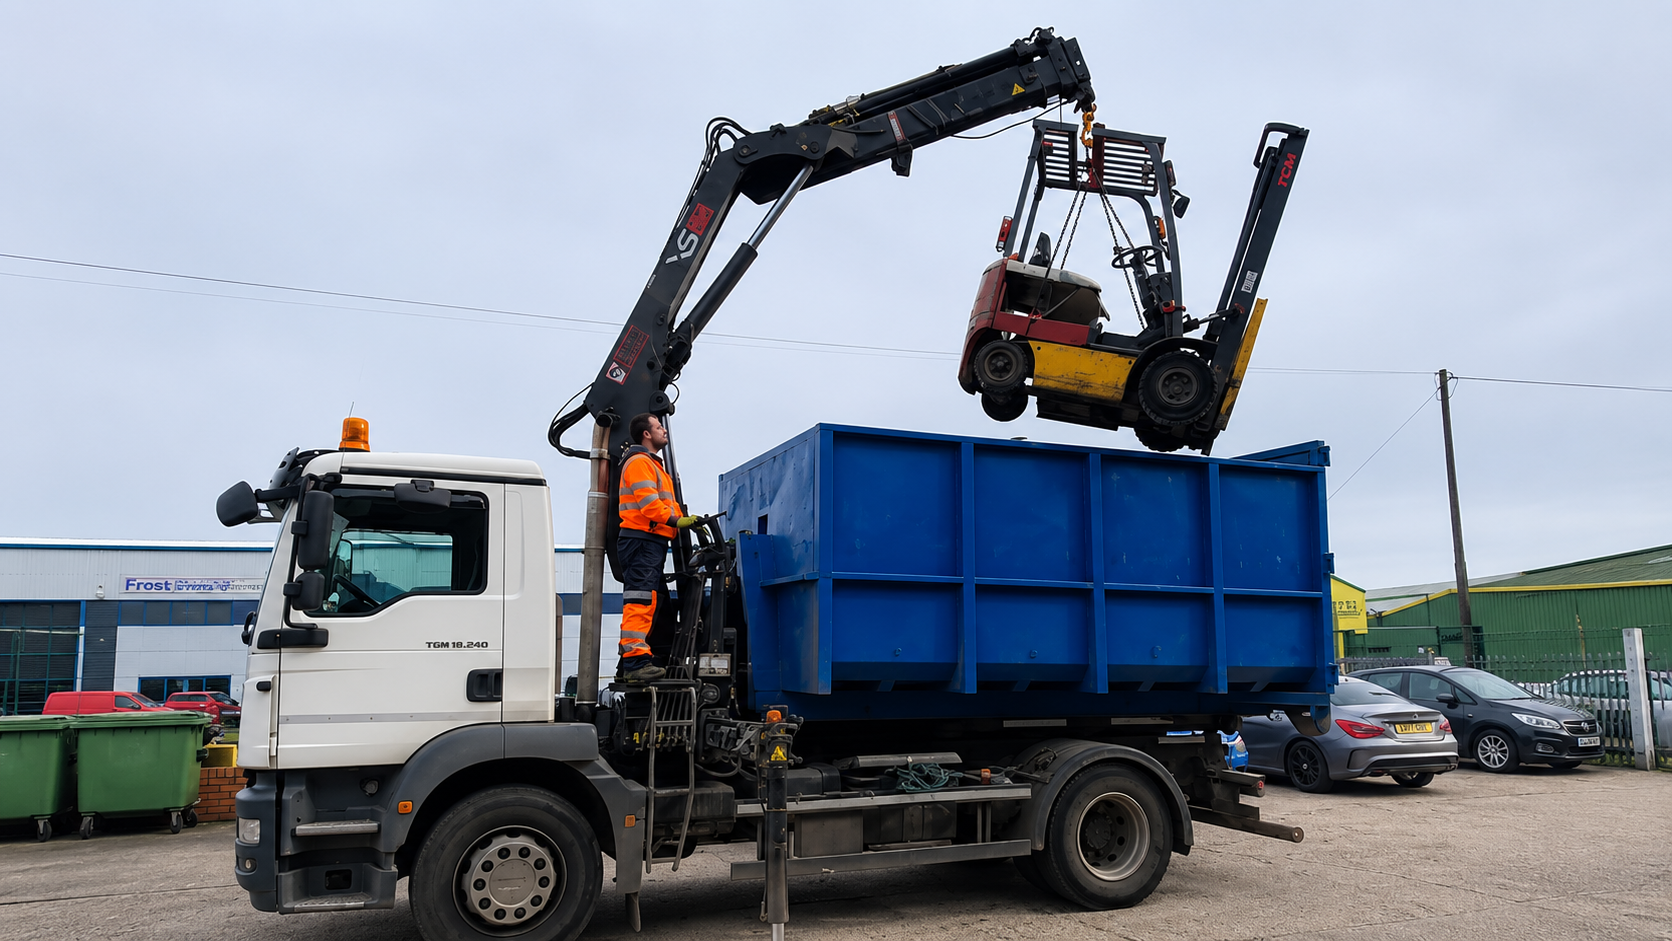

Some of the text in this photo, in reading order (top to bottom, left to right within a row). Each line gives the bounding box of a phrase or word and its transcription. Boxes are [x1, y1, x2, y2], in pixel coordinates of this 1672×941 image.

[1277, 152, 1297, 188] TCM
[125, 578, 173, 591] Frost
[425, 641, 489, 649] TGM 18.240
